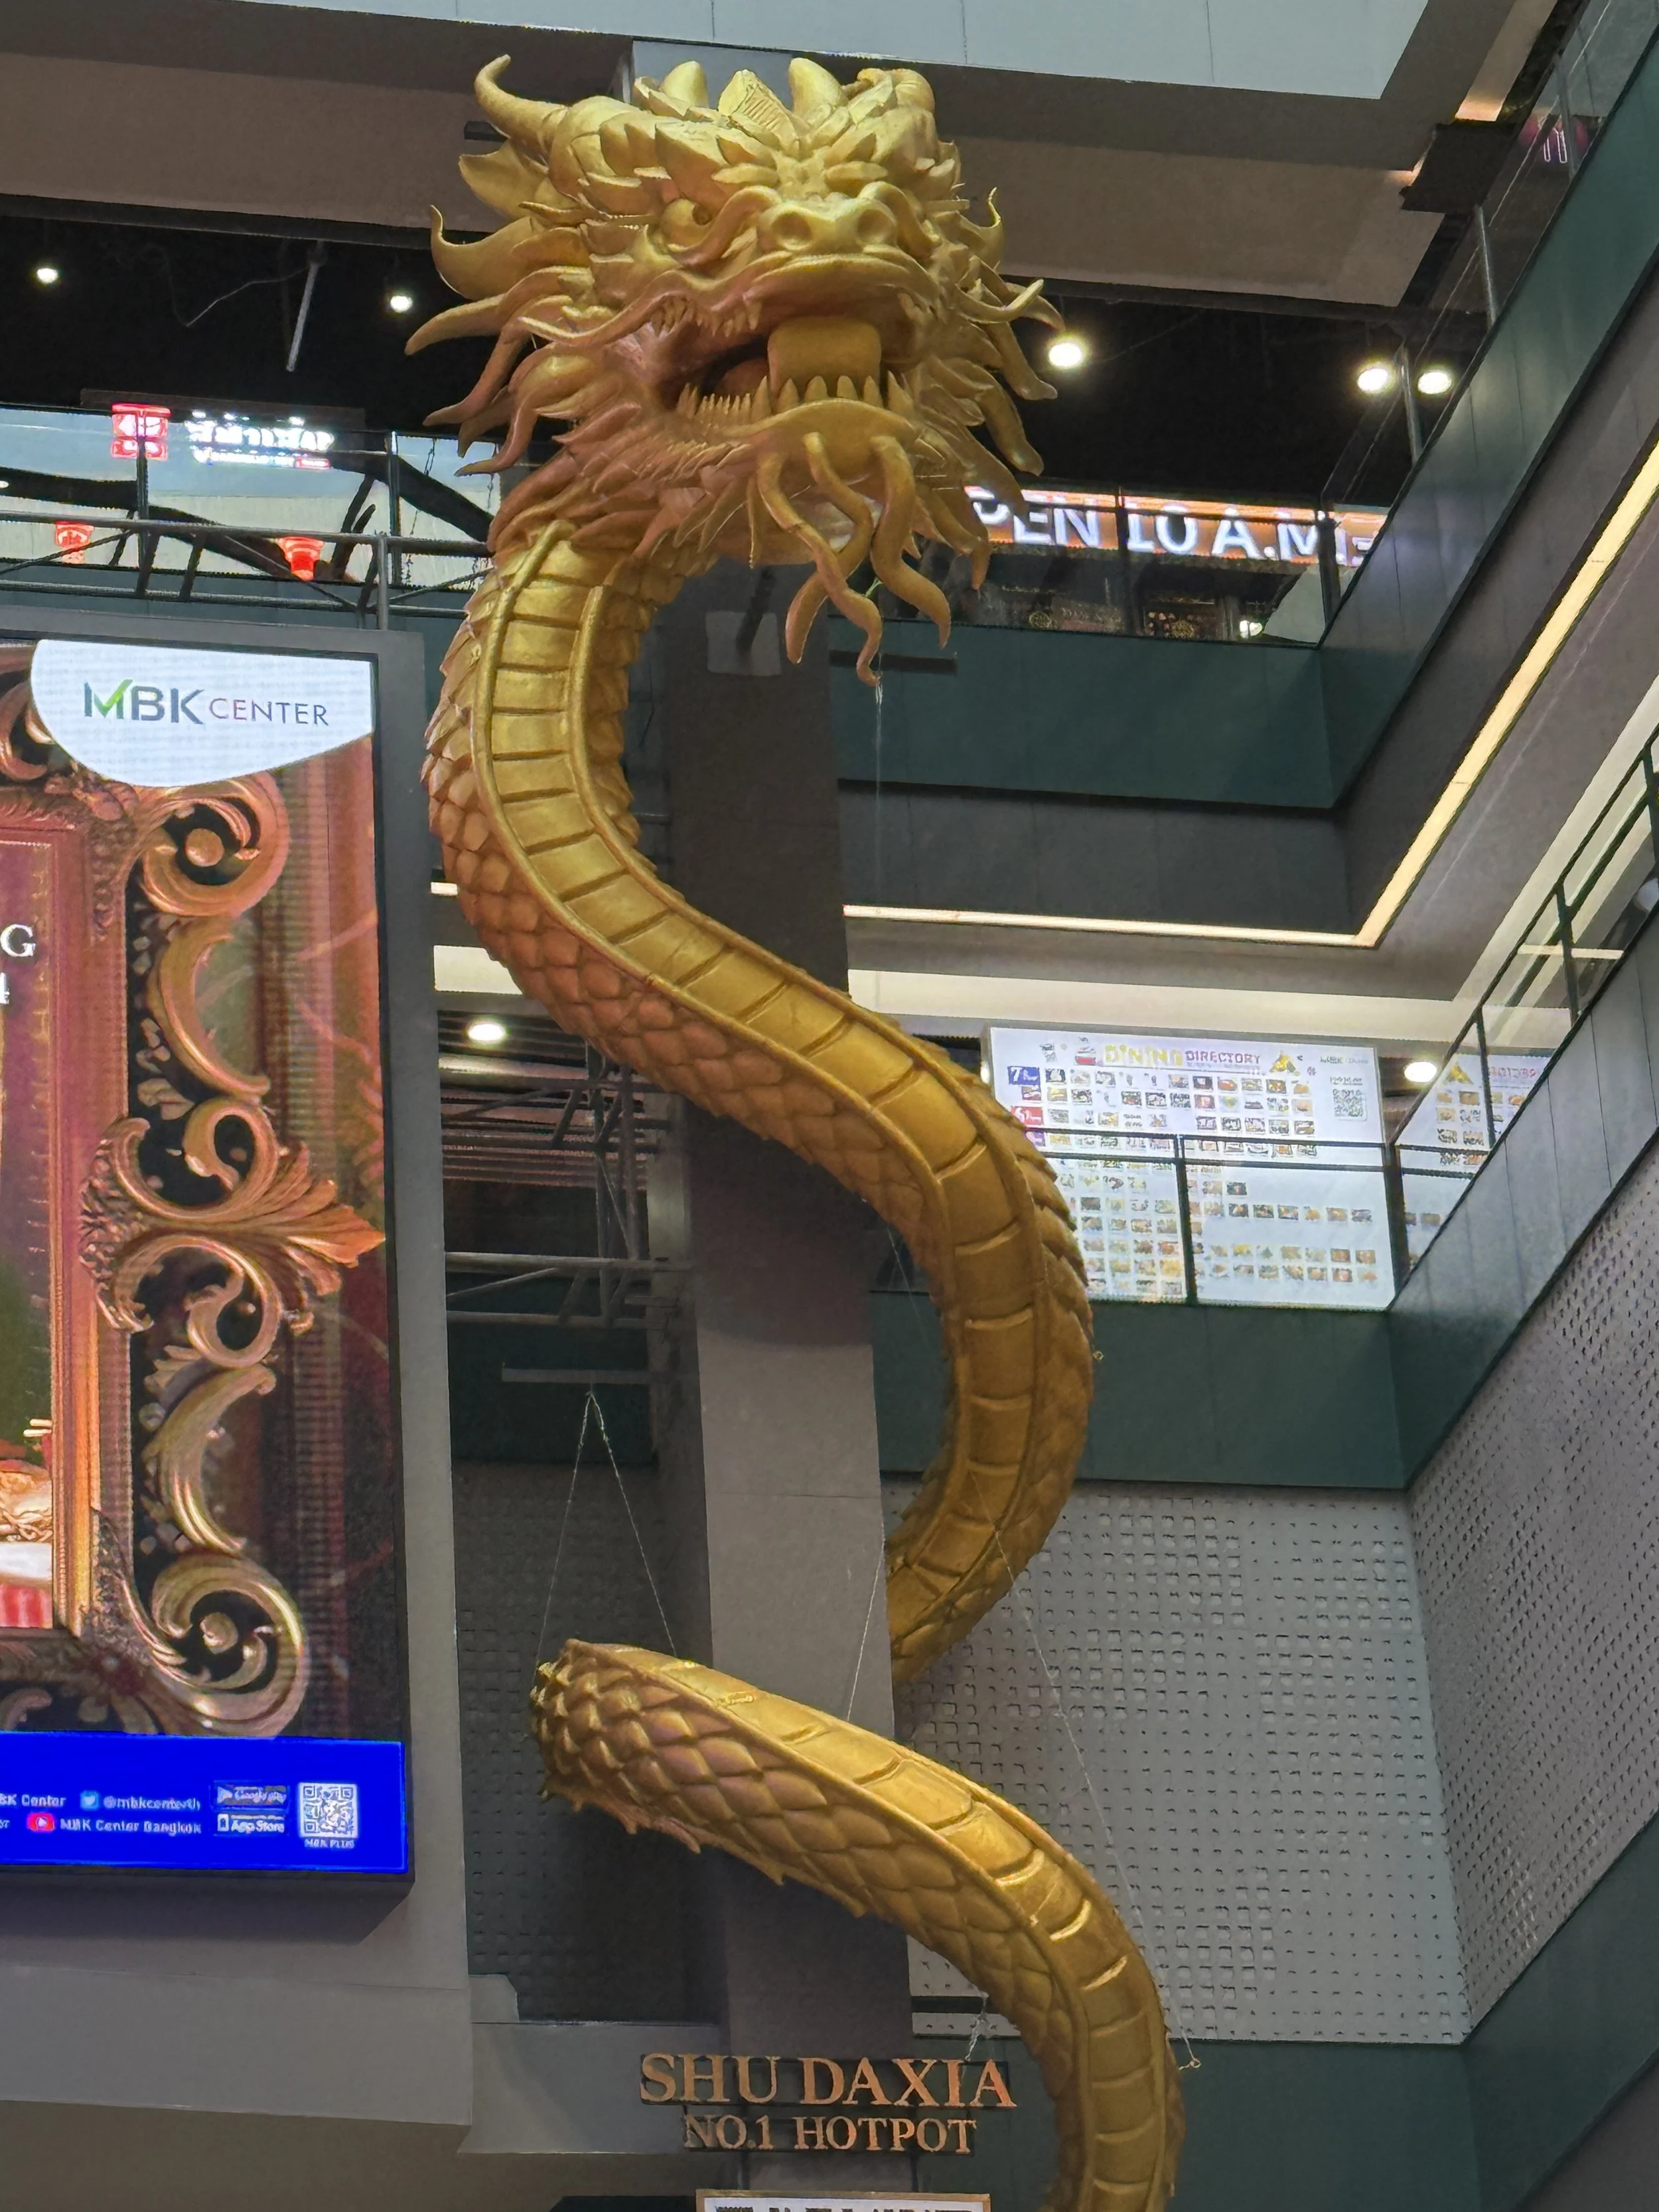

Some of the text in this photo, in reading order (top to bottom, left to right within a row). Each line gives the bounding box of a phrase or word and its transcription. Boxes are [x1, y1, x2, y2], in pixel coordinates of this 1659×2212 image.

[84, 679, 329, 726] MBK CENTER
[1185, 1050, 1261, 1065] DIRECTORY
[21, 1794, 66, 1807] Center
[96, 1819, 139, 1832] Center
[255, 1820, 285, 1833] Store
[640, 2052, 1018, 2108] SHU DAXIA
[684, 2114, 977, 2155] NO.1 HOTPOT
